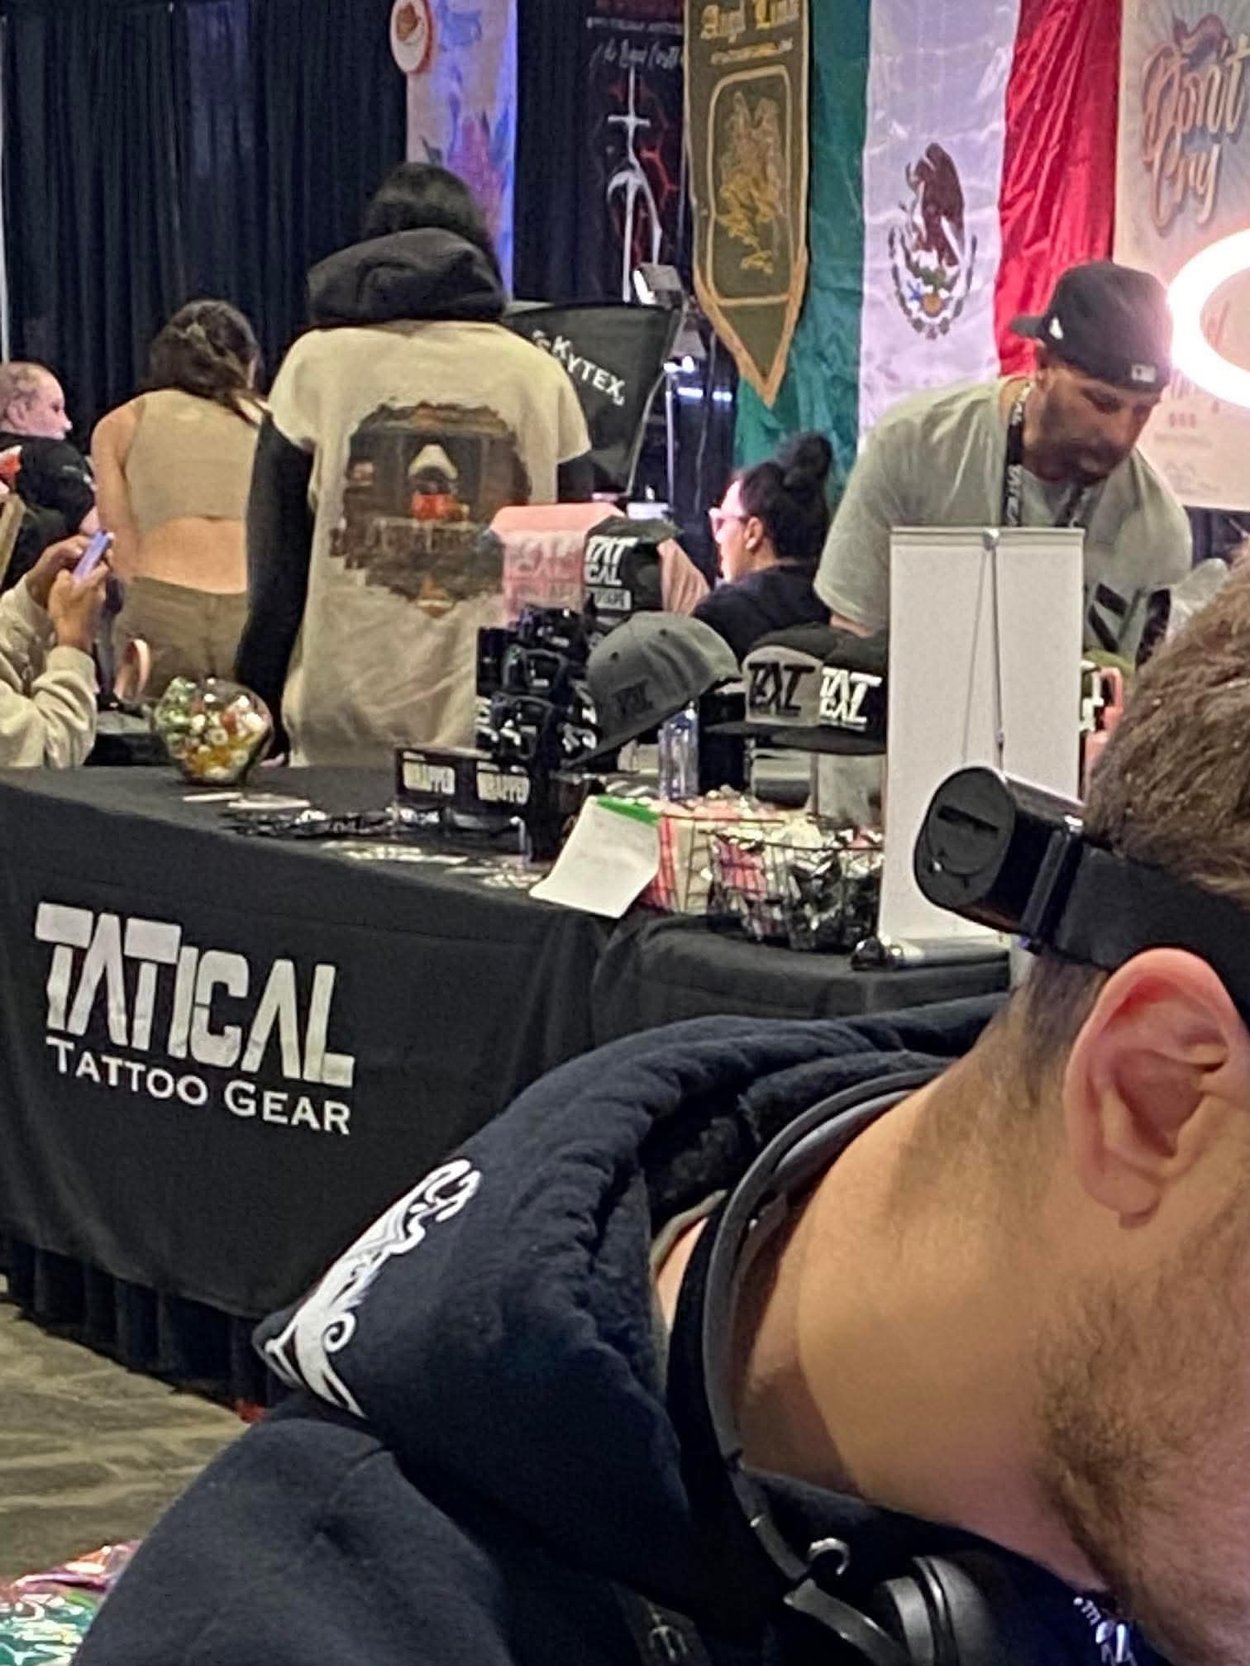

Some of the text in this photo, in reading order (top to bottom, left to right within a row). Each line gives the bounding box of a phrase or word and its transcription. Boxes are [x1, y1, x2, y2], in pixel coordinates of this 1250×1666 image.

[35, 901, 355, 1088] TATICAL
[46, 1035, 351, 1135] TATTOO GEAR
